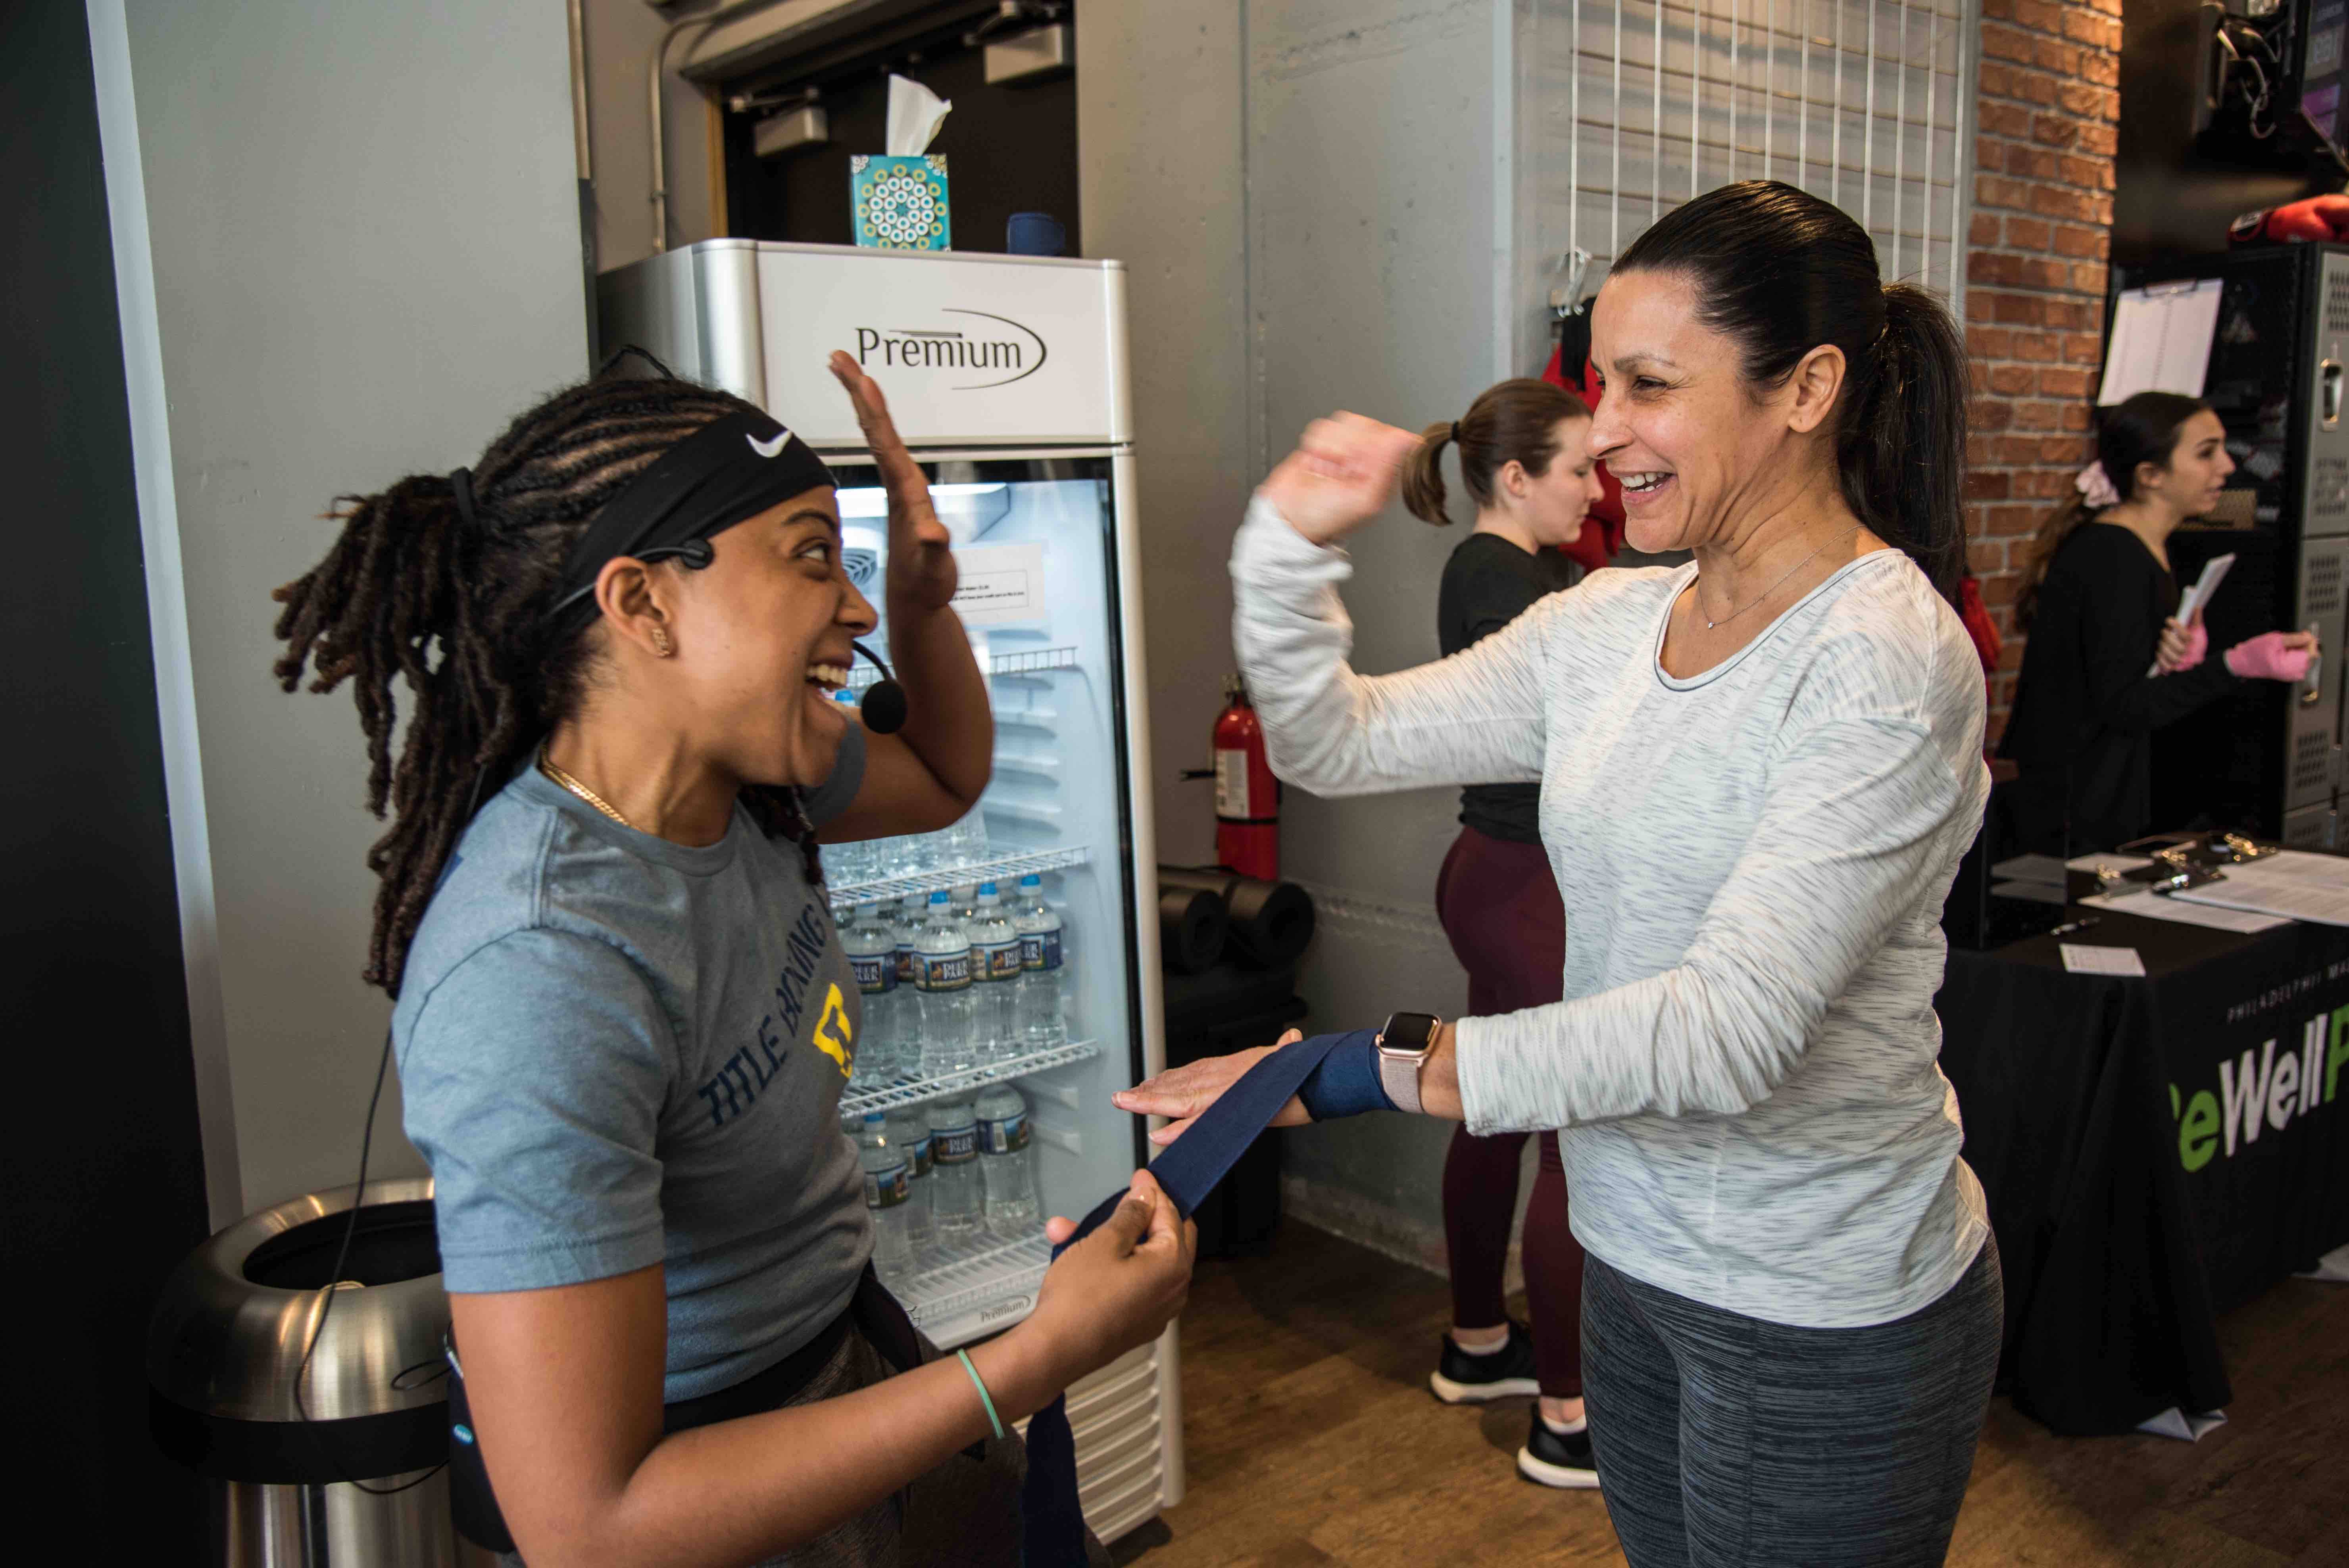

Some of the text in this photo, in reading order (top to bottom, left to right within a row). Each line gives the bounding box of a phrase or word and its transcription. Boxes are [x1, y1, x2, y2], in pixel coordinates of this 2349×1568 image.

[855, 328, 1021, 368] Premium
[943, 960, 967, 972] DEER
[943, 968, 968, 980] PARK
[698, 904, 827, 1125] TITLE BOXING
[981, 1301, 1025, 1322] Premium
